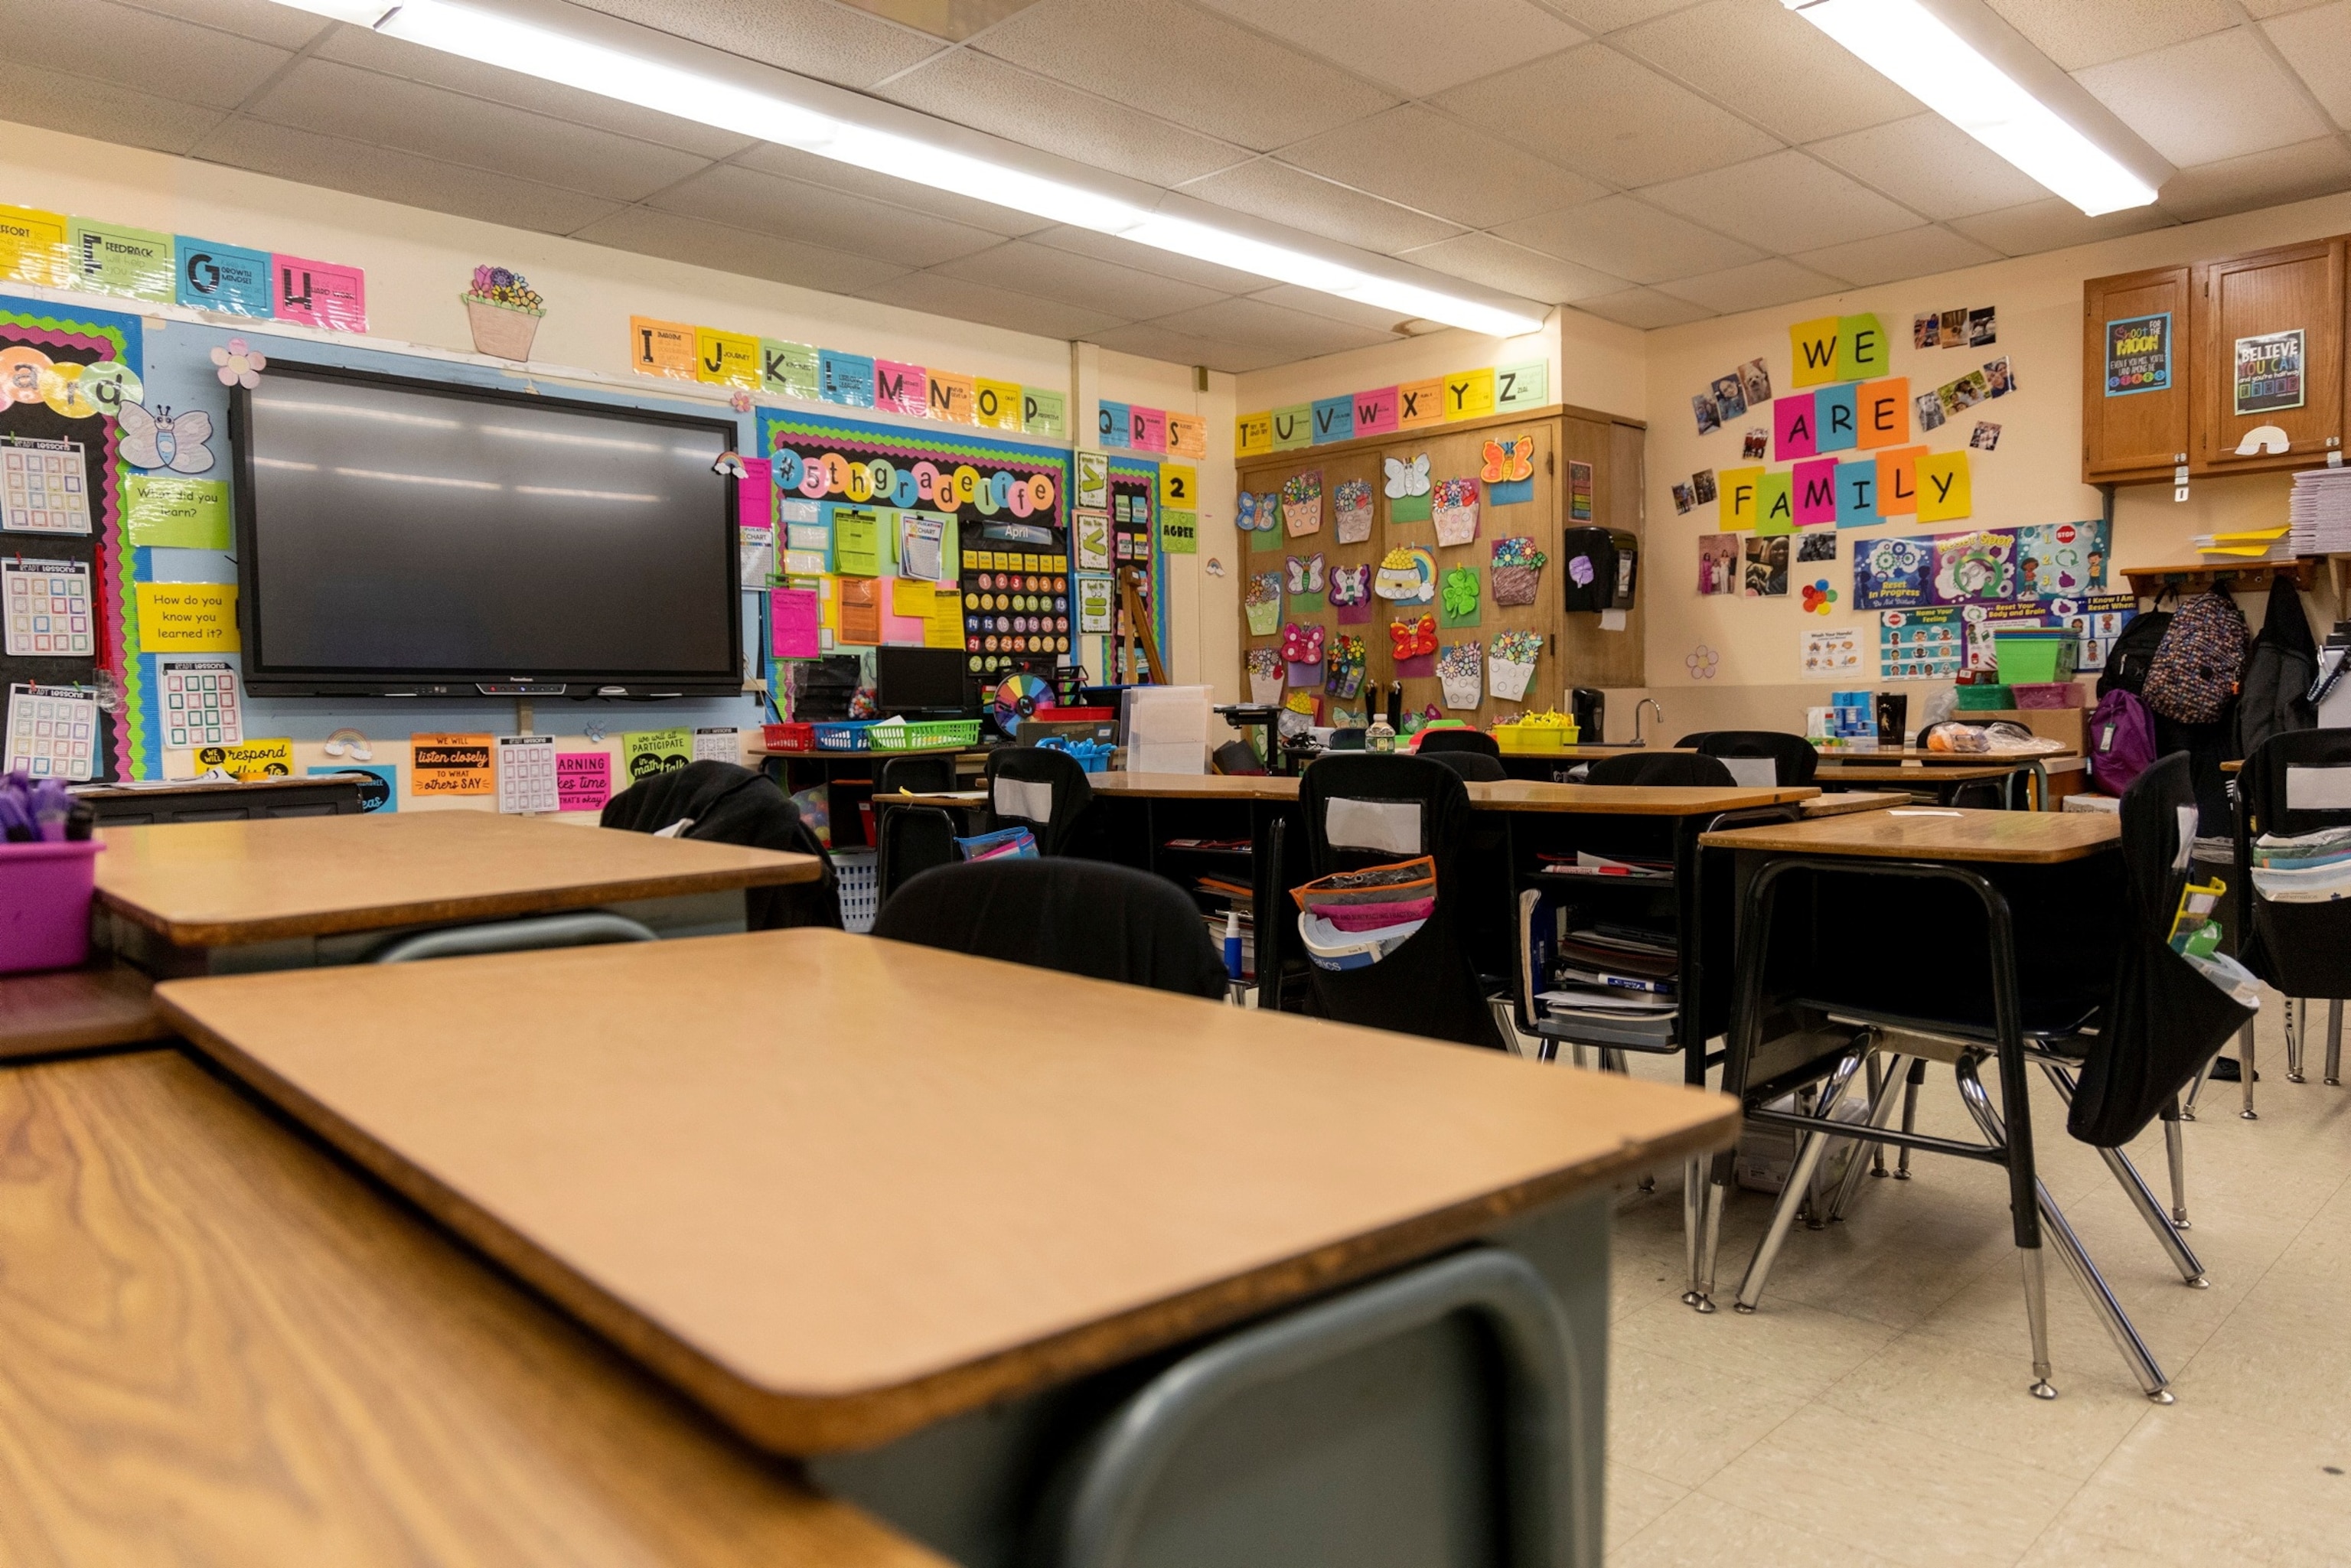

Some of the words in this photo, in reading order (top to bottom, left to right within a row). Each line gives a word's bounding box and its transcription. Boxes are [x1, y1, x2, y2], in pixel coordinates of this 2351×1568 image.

[0, 224, 30, 238] FFORT
[105, 241, 154, 259] FEEDBACK
[187, 253, 220, 294] G
[221, 266, 252, 278] GROWTH
[221, 275, 253, 285] MINDSET
[282, 269, 312, 310] H
[311, 285, 331, 295] HARD
[2150, 327, 2161, 335] THE
[641, 328, 654, 363] I
[1803, 330, 1875, 369] WE
[2116, 334, 2159, 355] MOON
[2241, 340, 2298, 363] BELIEVE
[704, 342, 722, 373] J
[723, 351, 750, 361] JOURNEY
[2128, 357, 2137, 366] YOU
[766, 350, 787, 383] K
[2239, 360, 2265, 377] YOU
[2271, 354, 2300, 372] CAN
[825, 360, 837, 392] L
[2111, 371, 2164, 386] STARS
[2252, 373, 2273, 383] you're
[2274, 370, 2300, 378] halfway
[879, 370, 903, 402] M
[1500, 373, 1516, 403] Z
[931, 379, 951, 409] N
[1450, 383, 1469, 410] Y
[980, 389, 998, 416] O
[1025, 396, 1038, 422] P
[1403, 392, 1417, 419] X
[1316, 408, 1334, 434] V
[1358, 403, 1378, 425] W
[1788, 398, 1896, 443] ARE
[1099, 409, 1113, 435] Q
[1134, 415, 1145, 440] R
[1276, 415, 1293, 440] U
[1170, 421, 1179, 446] S
[1240, 423, 1249, 447] T
[1169, 477, 1185, 498] 2
[1734, 468, 1954, 520] FAMILY
[177, 491, 194, 500] did
[198, 494, 218, 504] you
[161, 506, 197, 518] learn?
[1005, 525, 1029, 540] April
[1163, 525, 1194, 539] AGREE
[1936, 536, 1976, 553] Reset
[1980, 533, 2014, 549] Spot
[2042, 555, 2053, 566] 2.
[42, 565, 76, 574] Lessons
[999, 577, 1004, 586] 2
[1013, 579, 1019, 588] 3
[1030, 579, 1035, 588] 4
[1042, 580, 1048, 588] 5
[1057, 581, 1062, 589] 6
[1883, 580, 1907, 588] Reset
[2042, 575, 2052, 586] 3.
[1880, 588, 1920, 598] Progress
[153, 594, 181, 606] How
[184, 594, 198, 605] do
[203, 596, 223, 608] you
[1029, 599, 1035, 608] 11
[1042, 600, 1050, 608] 12
[1057, 601, 1065, 609] 13
[162, 611, 193, 622] know
[197, 614, 217, 625] you
[968, 618, 978, 629] 14
[984, 619, 993, 629] 15
[1016, 620, 1024, 629] 17
[1029, 620, 1037, 629] 18
[1042, 620, 1051, 629] 19
[1057, 620, 1065, 629] 20
[158, 628, 203, 638] learned
[207, 629, 223, 639] it?
[969, 639, 979, 649] 21
[986, 640, 996, 649] 22
[1001, 639, 1011, 649] 23
[1015, 640, 1024, 649] 24
[986, 659, 995, 669] 29
[51, 689, 84, 699] Lessons
[436, 737, 450, 745] WE
[651, 732, 666, 741] will
[667, 731, 677, 739] all
[632, 738, 684, 752] PARTICIPATE
[204, 755, 222, 764] WILL
[206, 748, 218, 758] WE
[227, 745, 286, 765] respond
[418, 751, 449, 764] listen
[450, 749, 488, 768] closely
[558, 758, 605, 771] ARNING
[638, 758, 648, 766] in
[268, 764, 285, 775] to
[424, 777, 459, 790] others
[461, 778, 481, 790] SAY
[557, 776, 576, 790] kes
[579, 775, 607, 789] time
[582, 794, 607, 807] okay!
[1390, 910, 1421, 918] FRACTIONS
